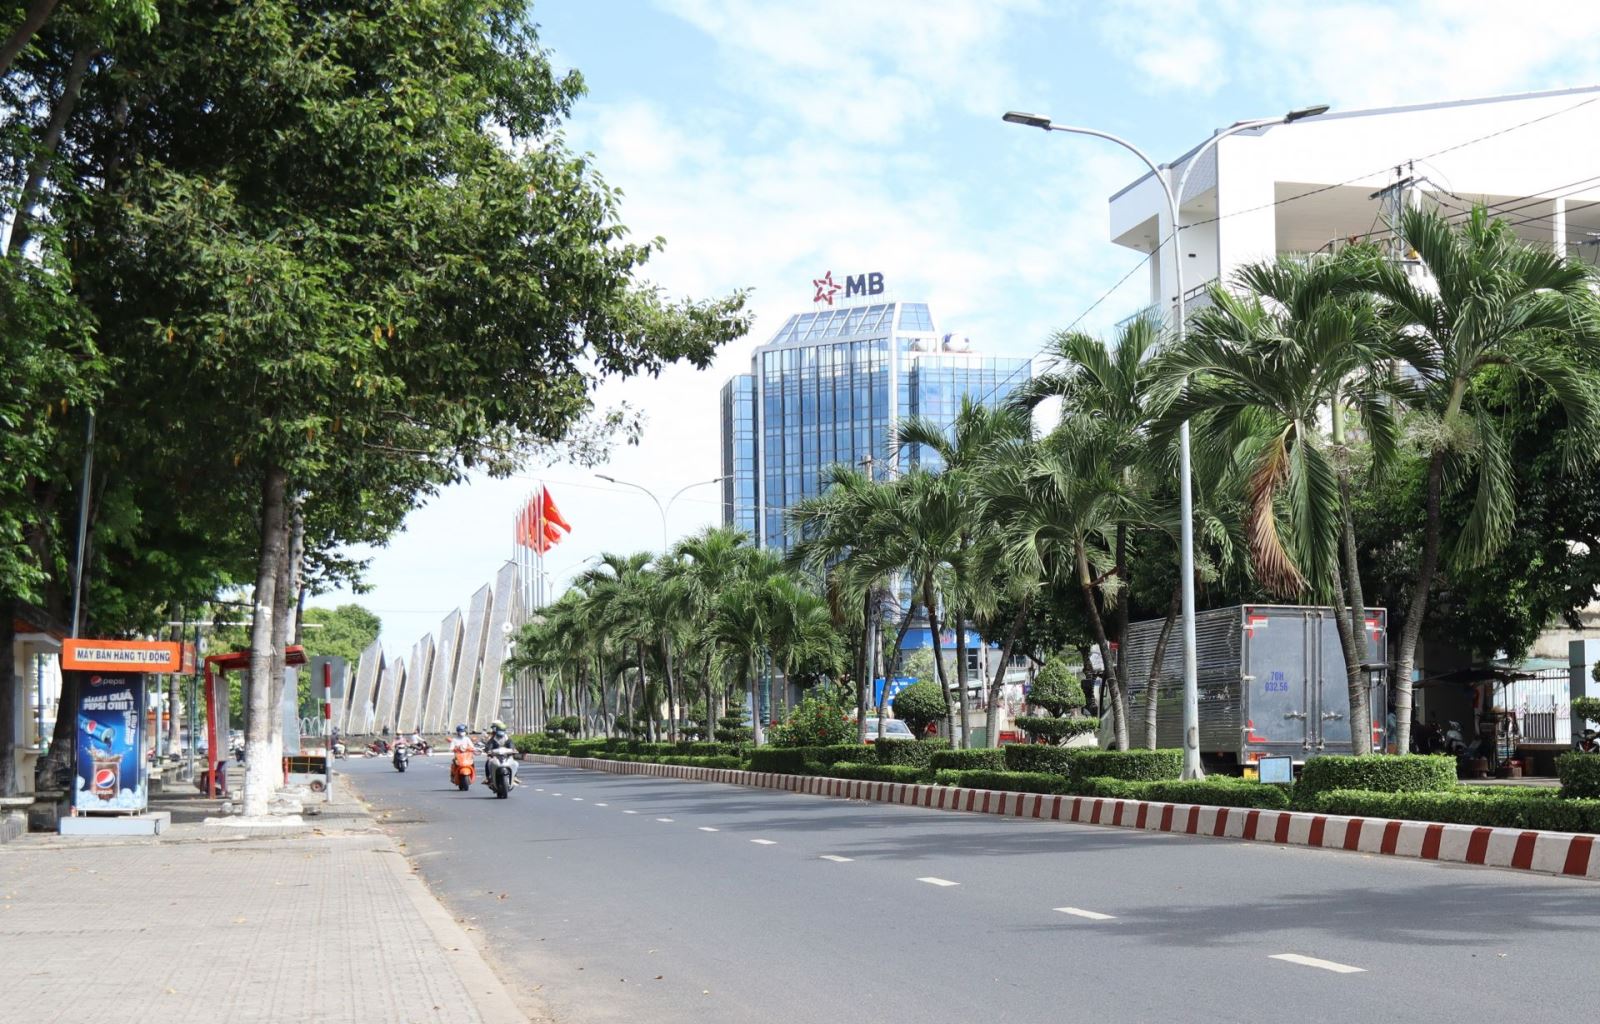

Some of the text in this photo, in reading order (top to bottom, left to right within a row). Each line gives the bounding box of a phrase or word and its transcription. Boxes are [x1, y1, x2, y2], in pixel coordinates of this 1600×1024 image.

[845, 271, 885, 298] MB
[102, 677, 126, 686] pepsi
[83, 702, 106, 711] PEPSI
